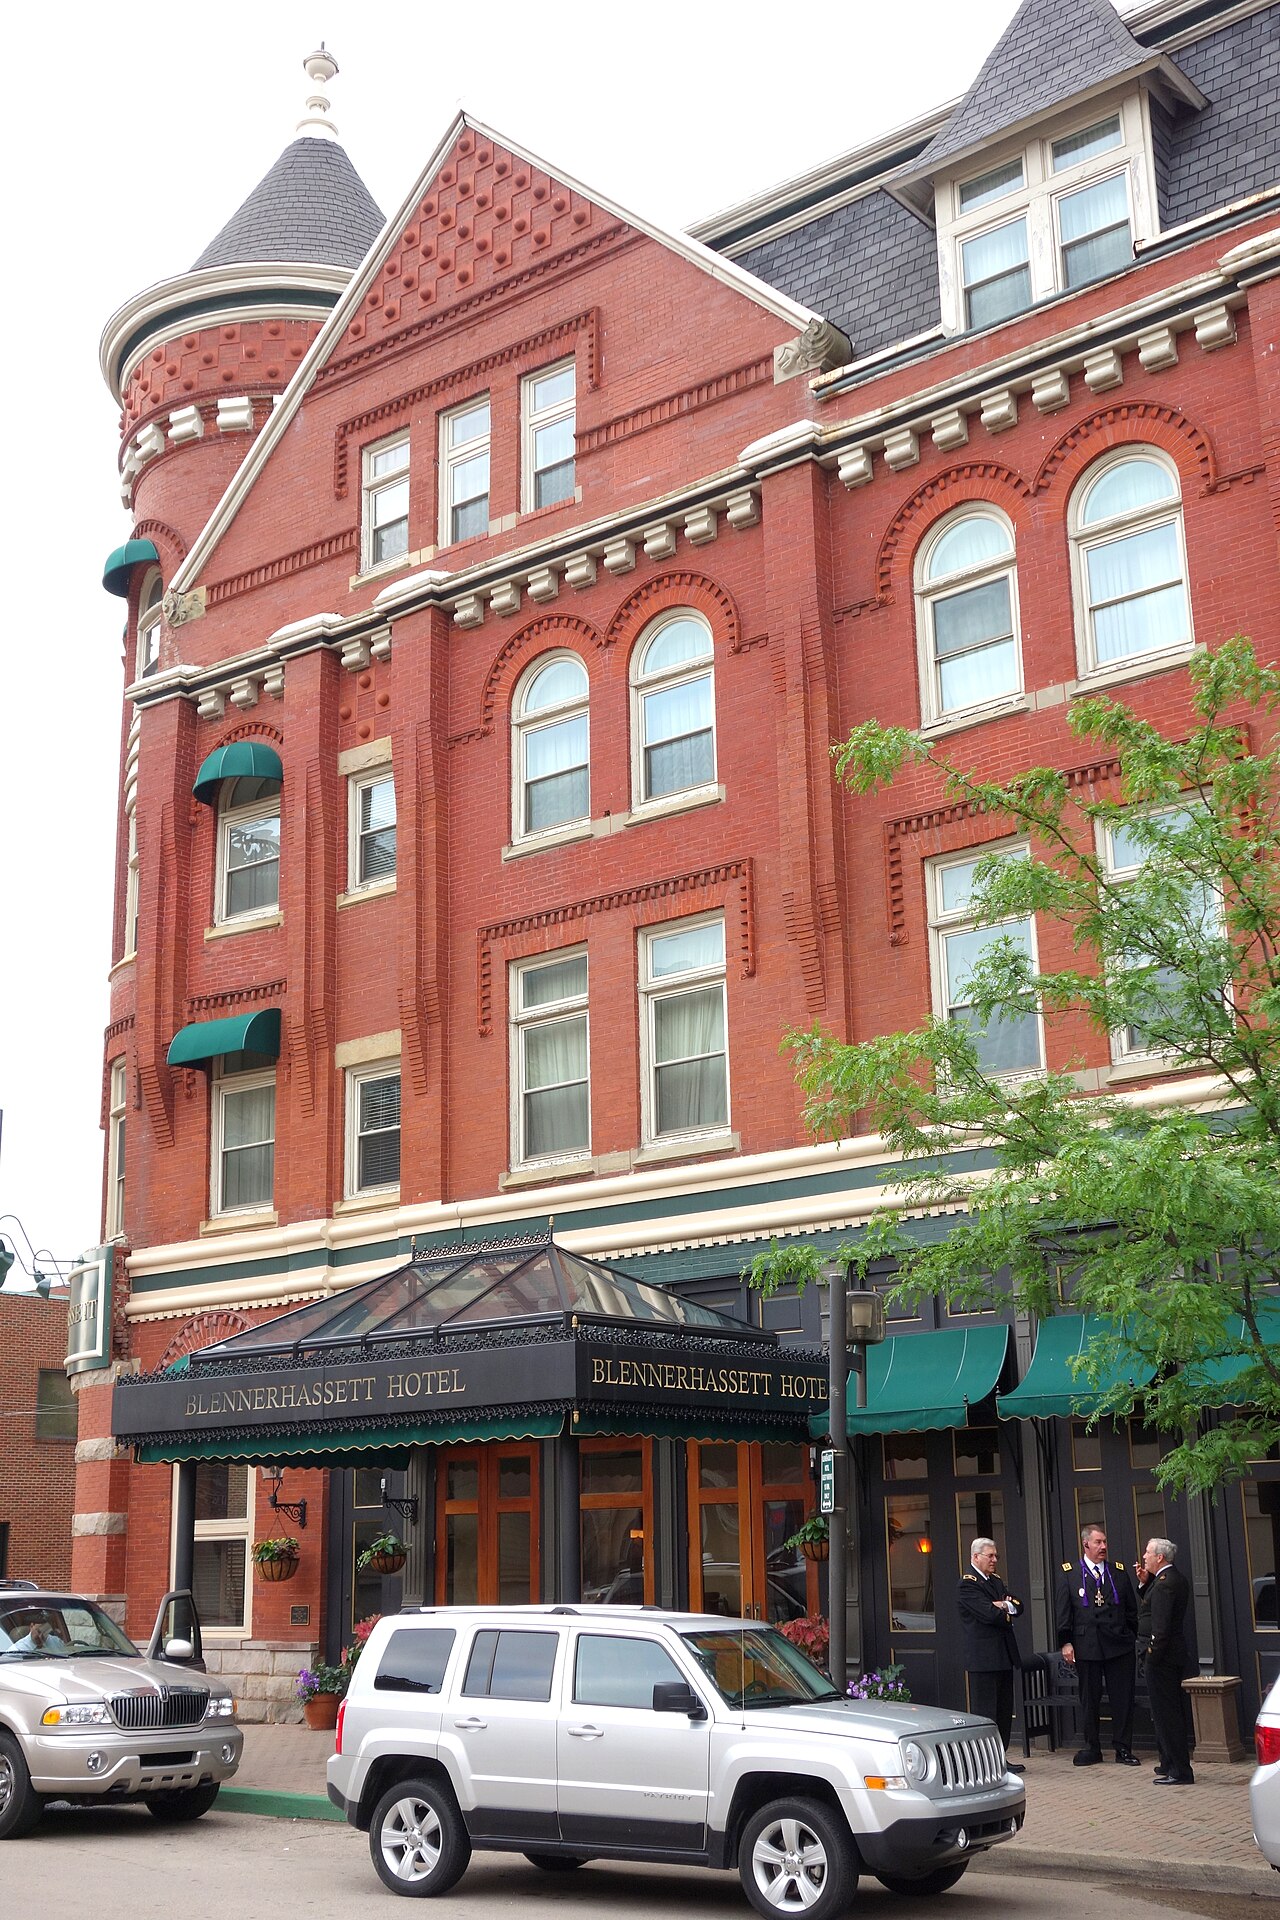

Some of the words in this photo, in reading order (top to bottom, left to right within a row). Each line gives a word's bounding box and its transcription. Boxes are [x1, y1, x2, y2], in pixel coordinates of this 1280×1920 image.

[184, 1377, 376, 1416] BLENNERHASSETT
[387, 1368, 466, 1399] HOTEL
[592, 1358, 772, 1396] BLENNERHASSETT
[780, 1374, 831, 1400] HOTE
